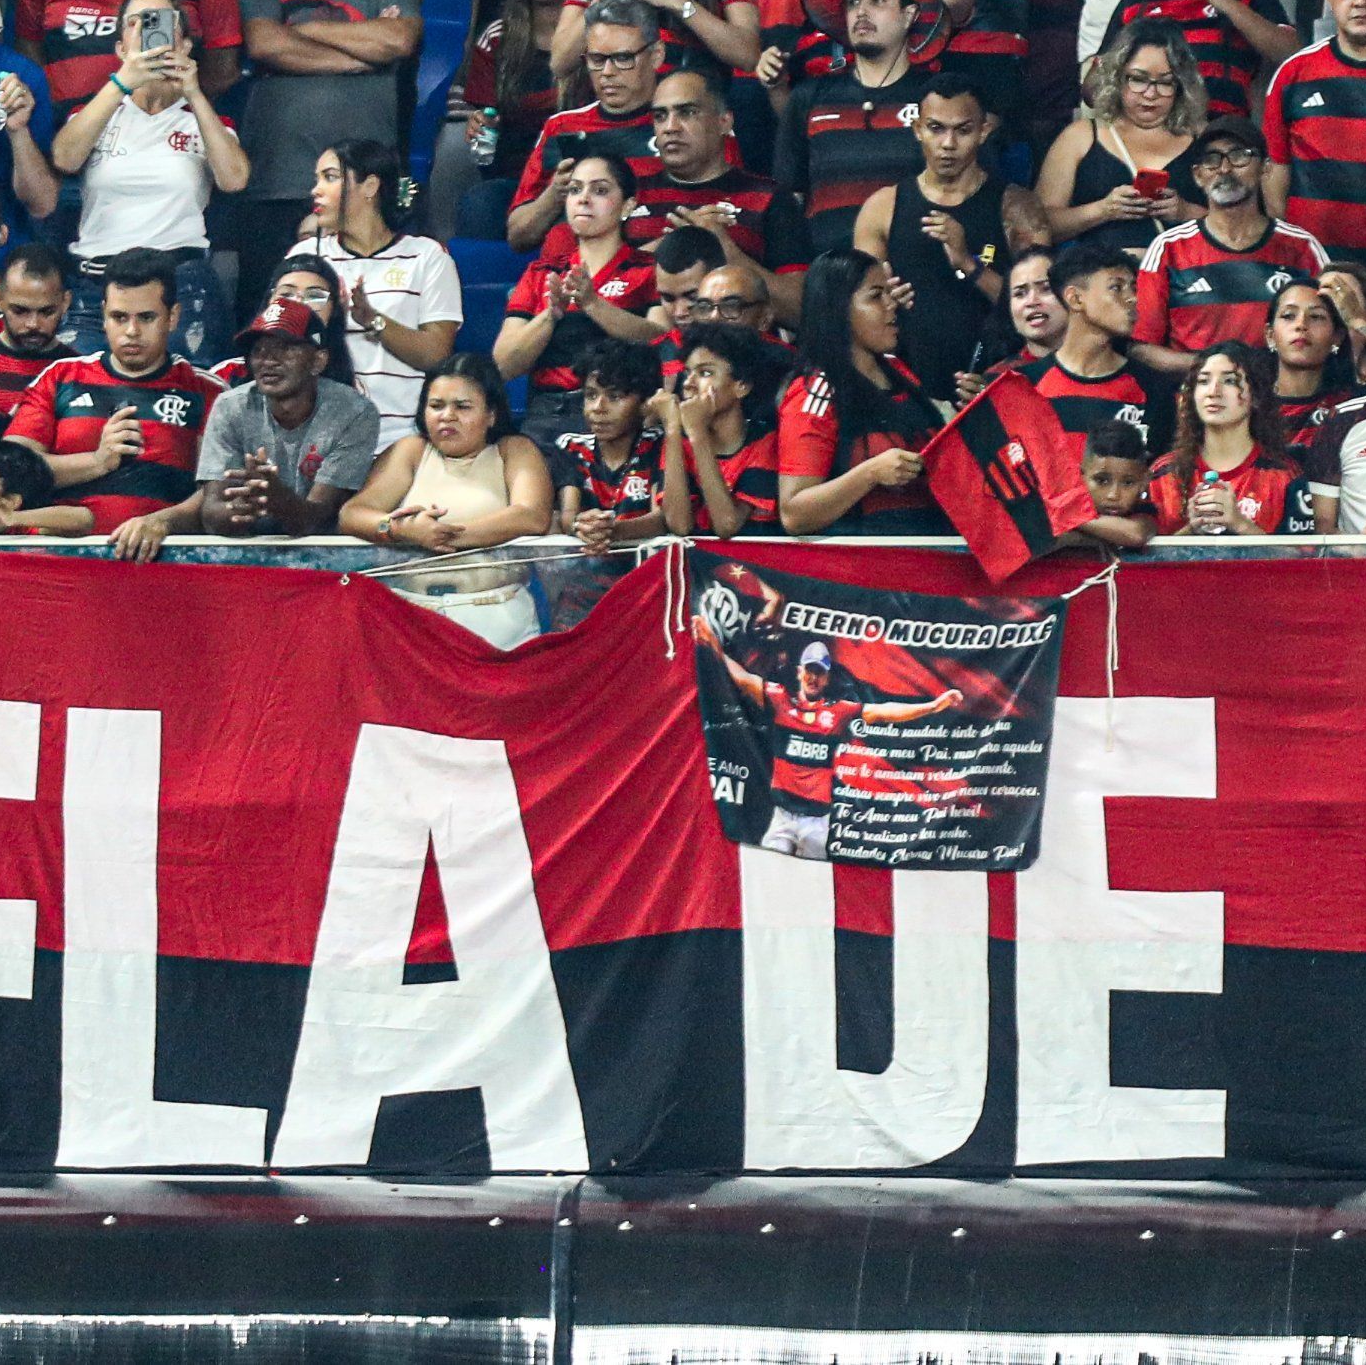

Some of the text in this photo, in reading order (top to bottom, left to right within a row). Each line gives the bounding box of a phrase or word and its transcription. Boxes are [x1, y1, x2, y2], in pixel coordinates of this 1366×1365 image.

[68, 6, 100, 15] banco
[782, 602, 885, 642] ETERNO
[886, 619, 997, 649] MUCURA
[849, 718, 899, 739] Quanta
[801, 741, 829, 761] BRB
[889, 748, 916, 759] meu
[718, 760, 749, 780] AMO
[836, 765, 858, 779] que
[860, 763, 873, 777] te
[833, 802, 853, 819] Te
[852, 807, 891, 823] Amo
[892, 814, 918, 823] meu
[832, 822, 860, 840] Vim
[738, 696, 1226, 1170] DE
